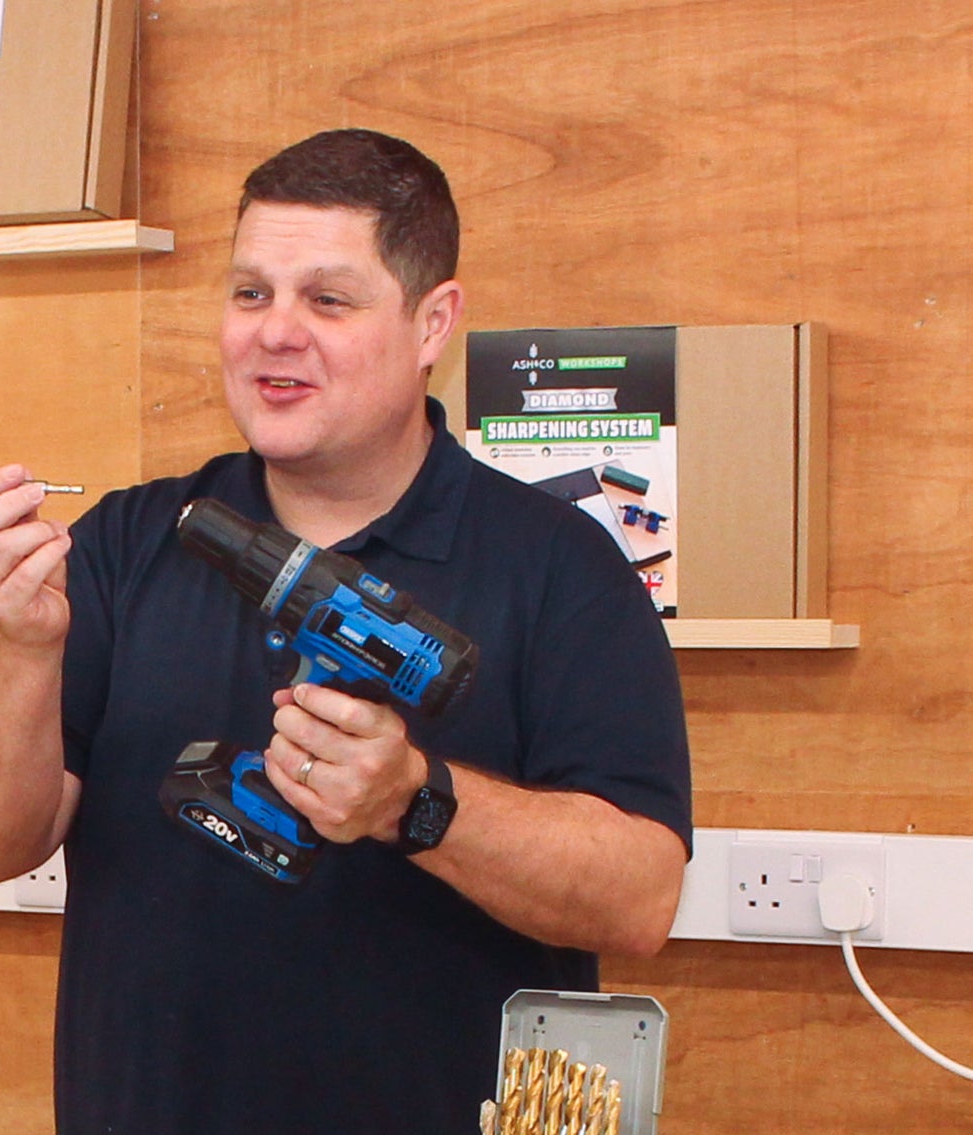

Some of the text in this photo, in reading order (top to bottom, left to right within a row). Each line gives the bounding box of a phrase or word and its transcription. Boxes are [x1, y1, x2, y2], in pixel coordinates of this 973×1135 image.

[560, 357, 626, 370] WORKSHOPS
[530, 393, 609, 408] DIAMOND
[487, 419, 653, 440] SHARPENING SYSTEM
